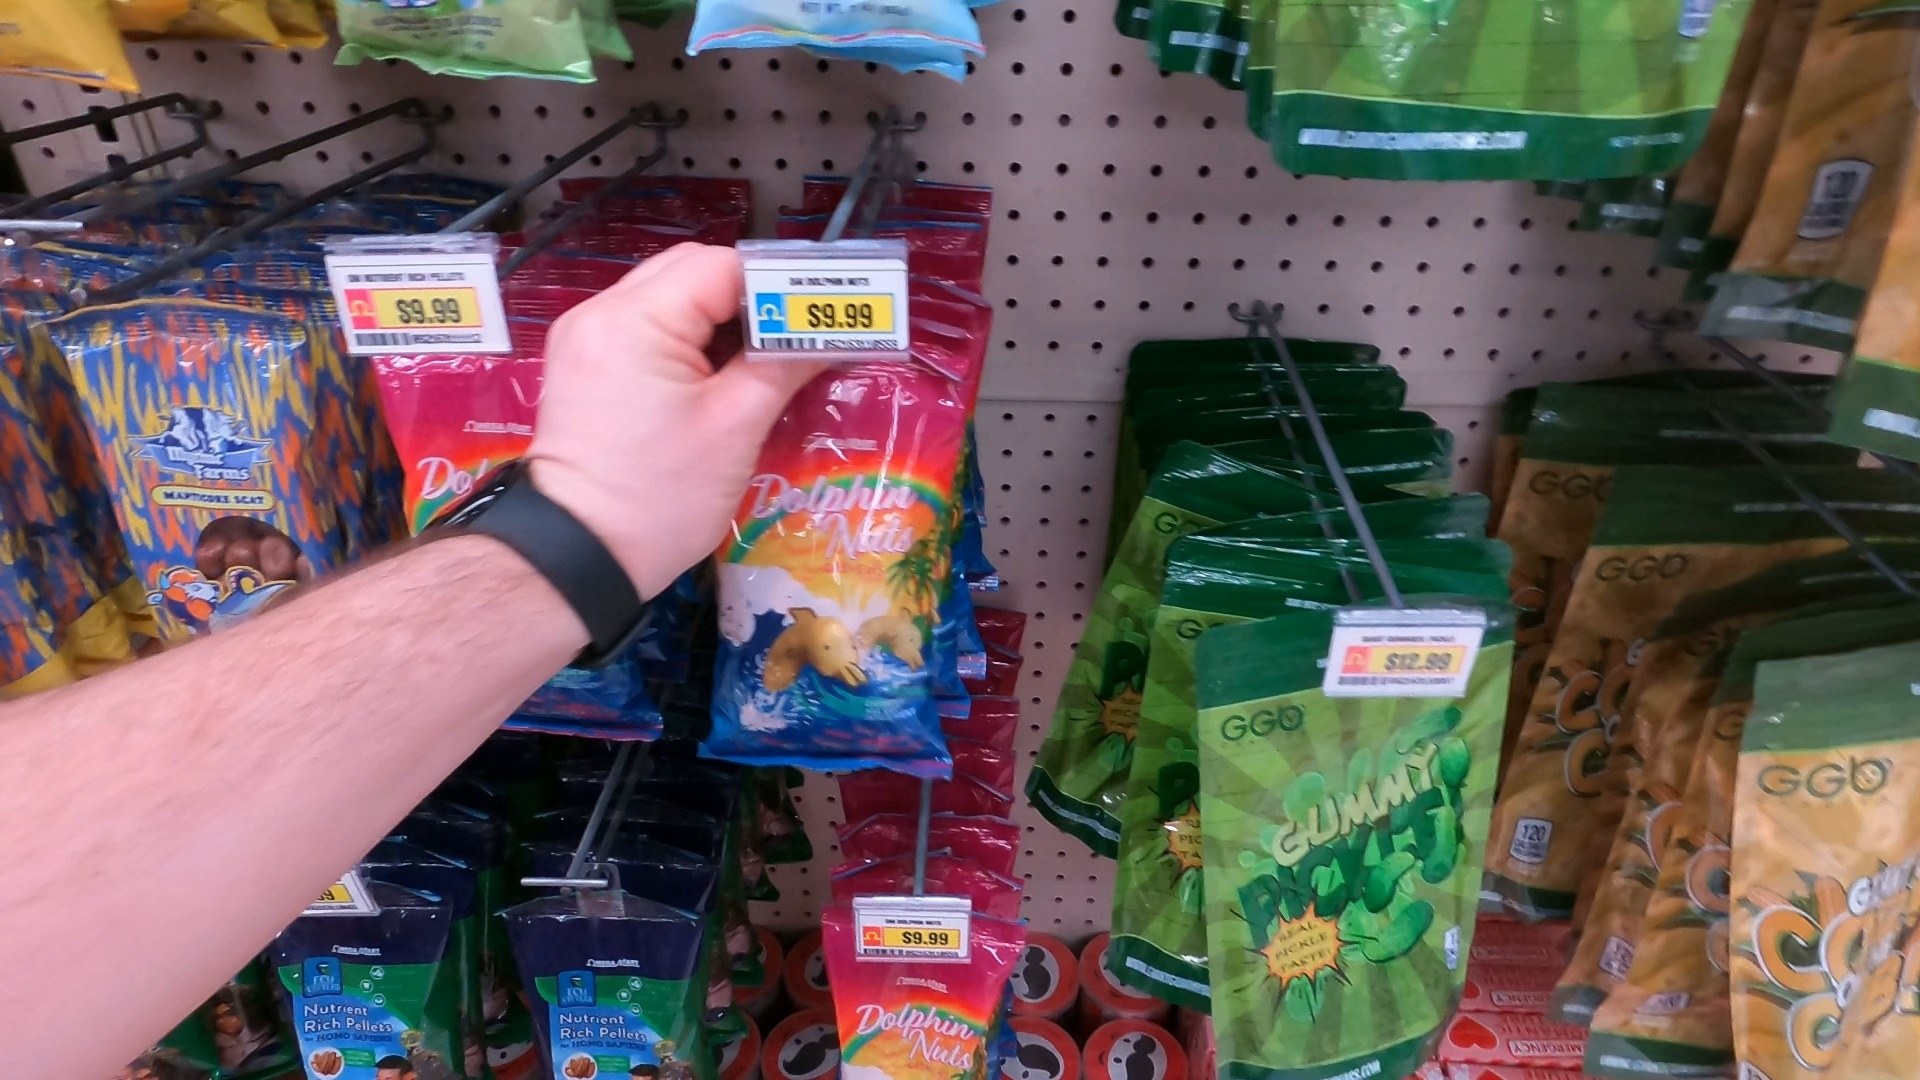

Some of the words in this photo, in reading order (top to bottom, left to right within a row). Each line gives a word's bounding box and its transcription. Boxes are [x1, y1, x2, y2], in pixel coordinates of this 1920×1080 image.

[396, 298, 462, 324] $9.99
[807, 303, 873, 328] $9.99
[750, 473, 918, 522] Dolphin
[812, 512, 914, 560] Nuts
[1384, 652, 1452, 671] $12.99
[1272, 742, 1439, 867] GUMMY
[902, 931, 949, 945] $9.99
[304, 1003, 368, 1017] Nutrient
[560, 1013, 624, 1025] Nutrient
[856, 1003, 974, 1040] Dolphin
[304, 1017, 341, 1033] Rich
[346, 1017, 393, 1032] Pellets
[560, 1027, 594, 1040] Rich
[600, 1027, 648, 1042] Pellets
[909, 1029, 971, 1069] Nuts
